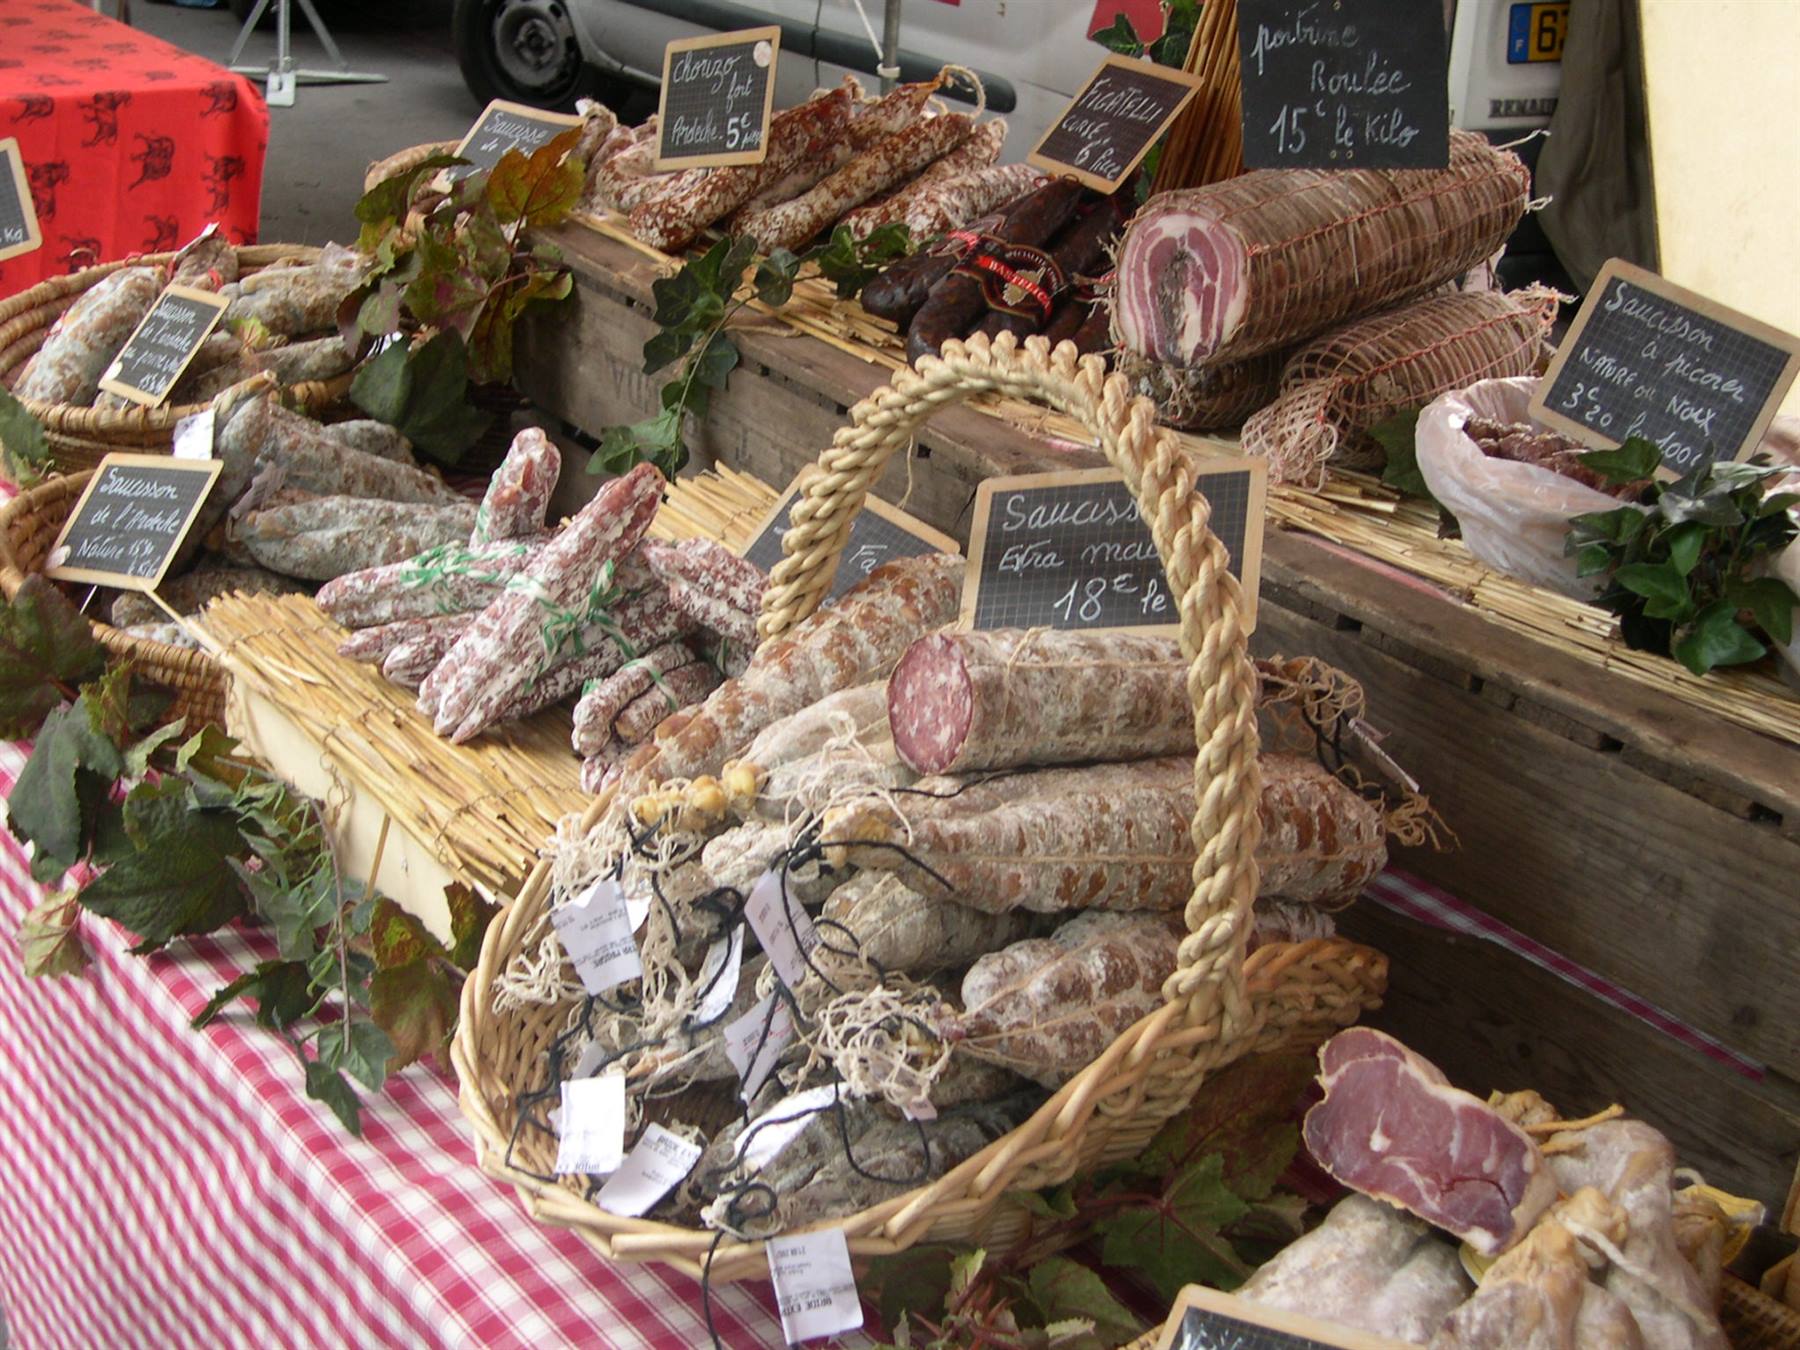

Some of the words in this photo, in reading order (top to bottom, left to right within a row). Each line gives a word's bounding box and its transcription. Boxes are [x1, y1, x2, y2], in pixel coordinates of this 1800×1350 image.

[1250, 2, 1360, 76] poitrine
[1515, 39, 1525, 53] F
[1334, 103, 1355, 147] le
[1488, 97, 1558, 118] RENAU
[1001, 494, 1143, 533] Sauciss
[1141, 577, 1168, 616] le
